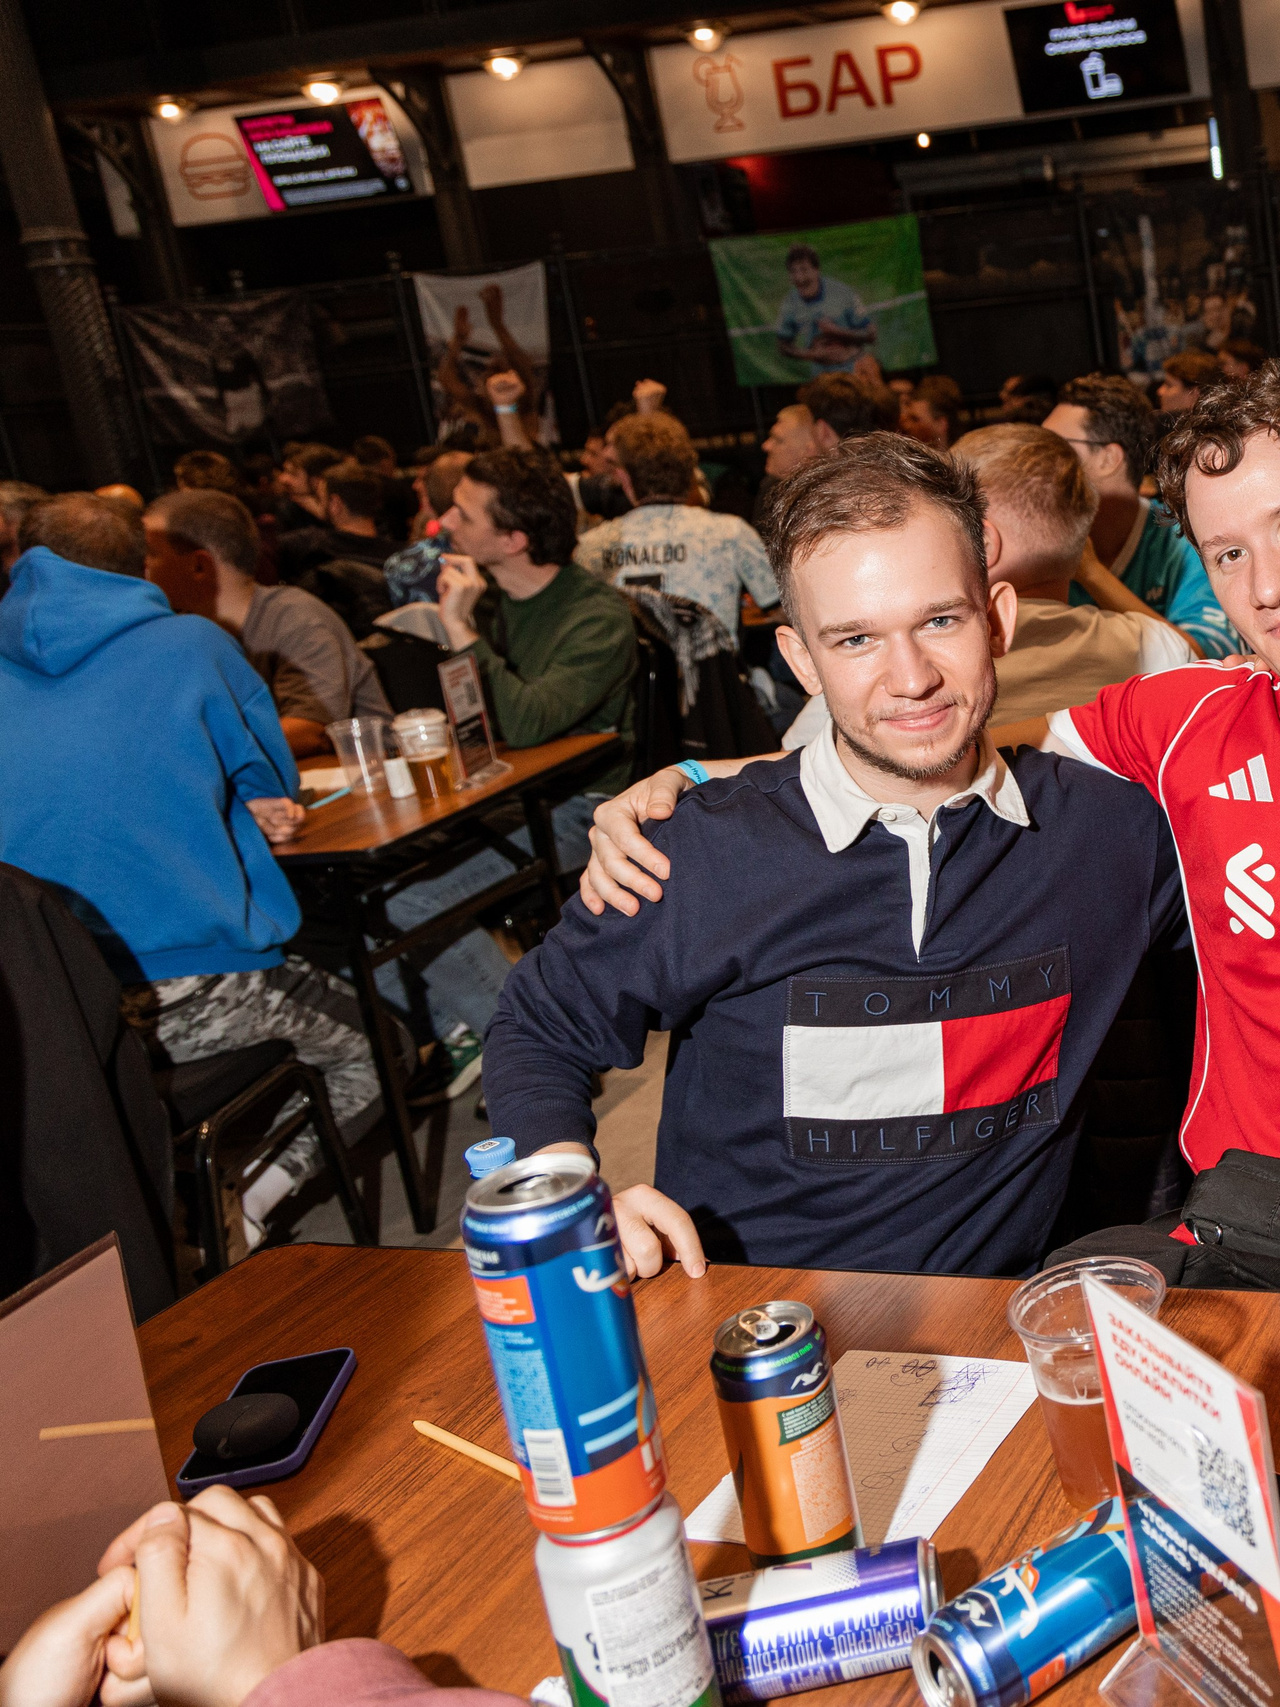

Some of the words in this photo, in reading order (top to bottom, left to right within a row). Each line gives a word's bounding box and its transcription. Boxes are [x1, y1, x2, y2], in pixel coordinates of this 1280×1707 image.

[771, 42, 923, 120] БАР
[602, 543, 685, 569] RONALDO
[805, 963, 1055, 1017] TOMMY
[808, 1093, 1042, 1153] HILFIGER
[1108, 1312, 1214, 1397] ЗАКАЗЫВАЙТЕ
[1111, 1332, 1137, 1357] ЕДУ
[1151, 1362, 1222, 1422] НАПИТКИ
[1115, 1350, 1173, 1403] ОНЛАЙН
[1137, 1499, 1189, 1552] ЧТОБЫ
[1188, 1543, 1259, 1614] СДЕЛАТЬ
[716, 1638, 828, 1685] УПОТРЕБЛЕНИЕ
[832, 1620, 920, 1660] ЧРЕЗМЕРНОЕ
